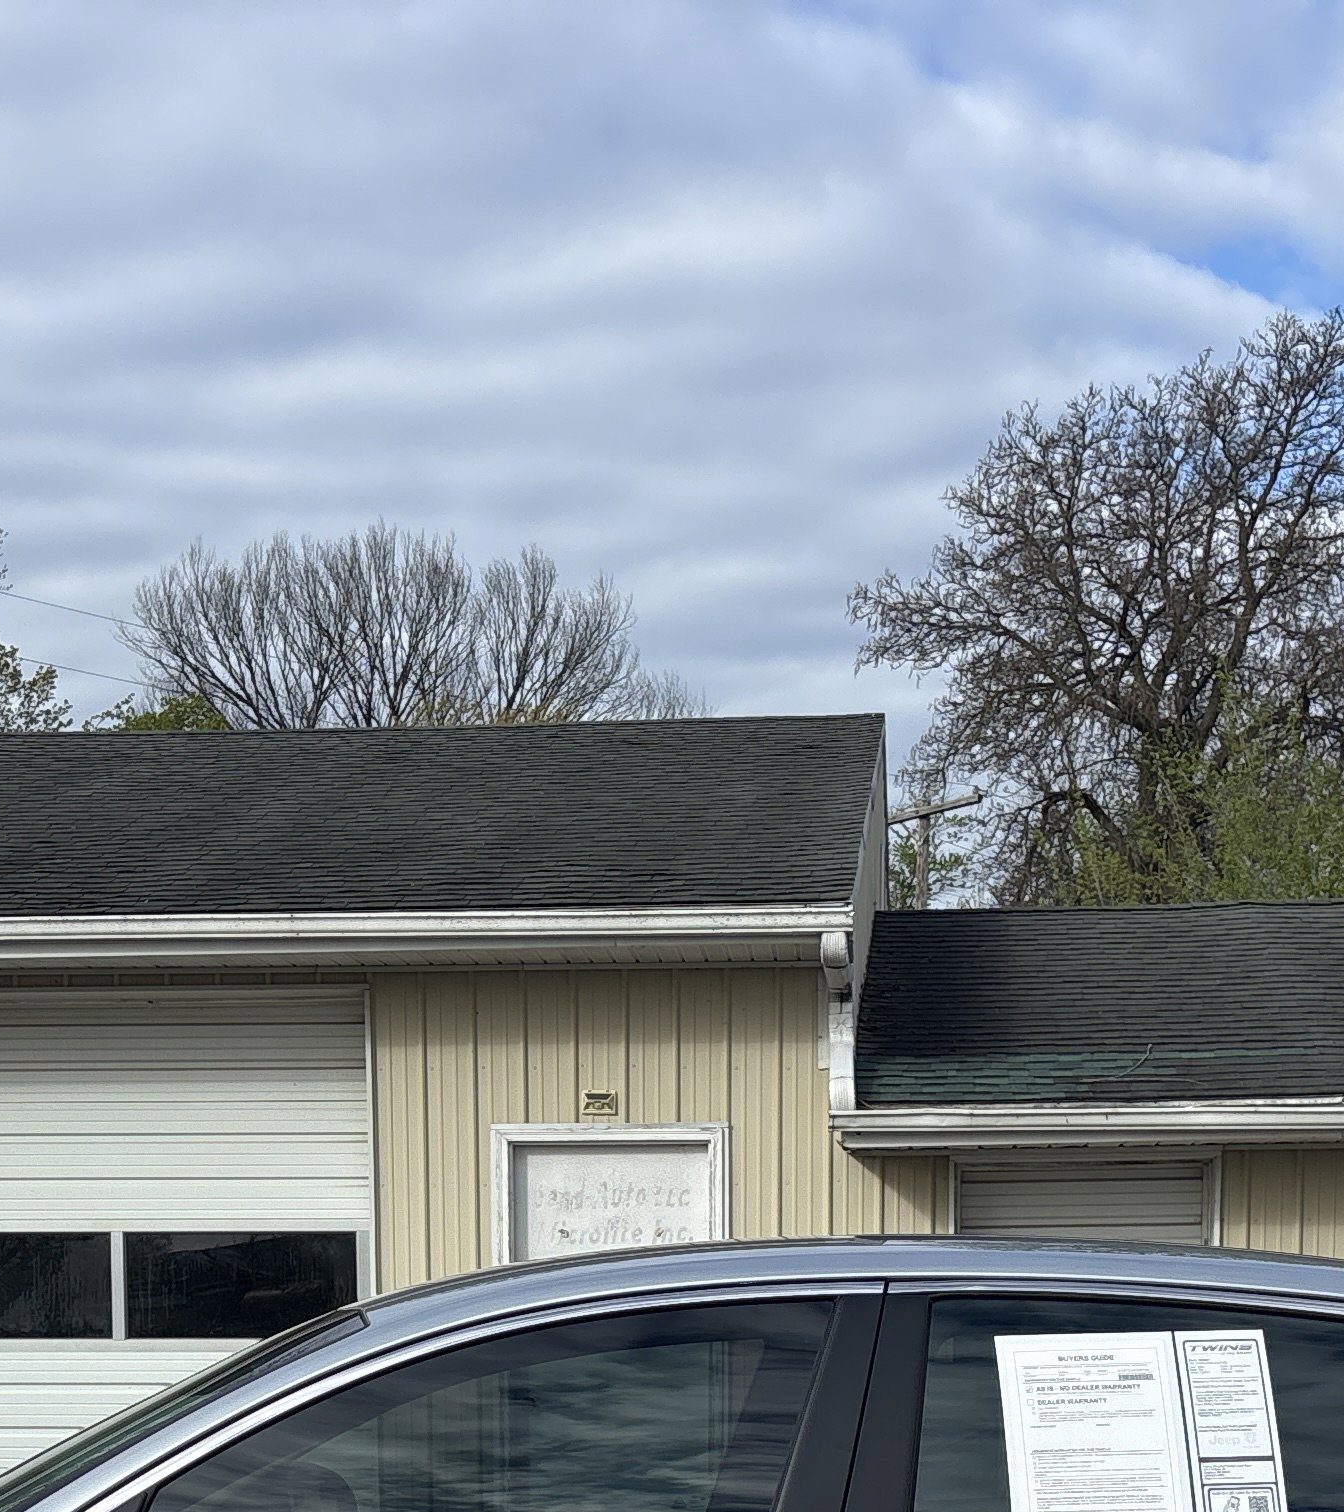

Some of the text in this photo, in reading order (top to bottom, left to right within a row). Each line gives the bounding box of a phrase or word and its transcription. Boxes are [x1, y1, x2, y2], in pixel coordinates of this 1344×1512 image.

[1188, 1343, 1253, 1352] TWINS
[1067, 1397, 1108, 1405] WARRANTY
[1208, 1435, 1241, 1446] Jeep
